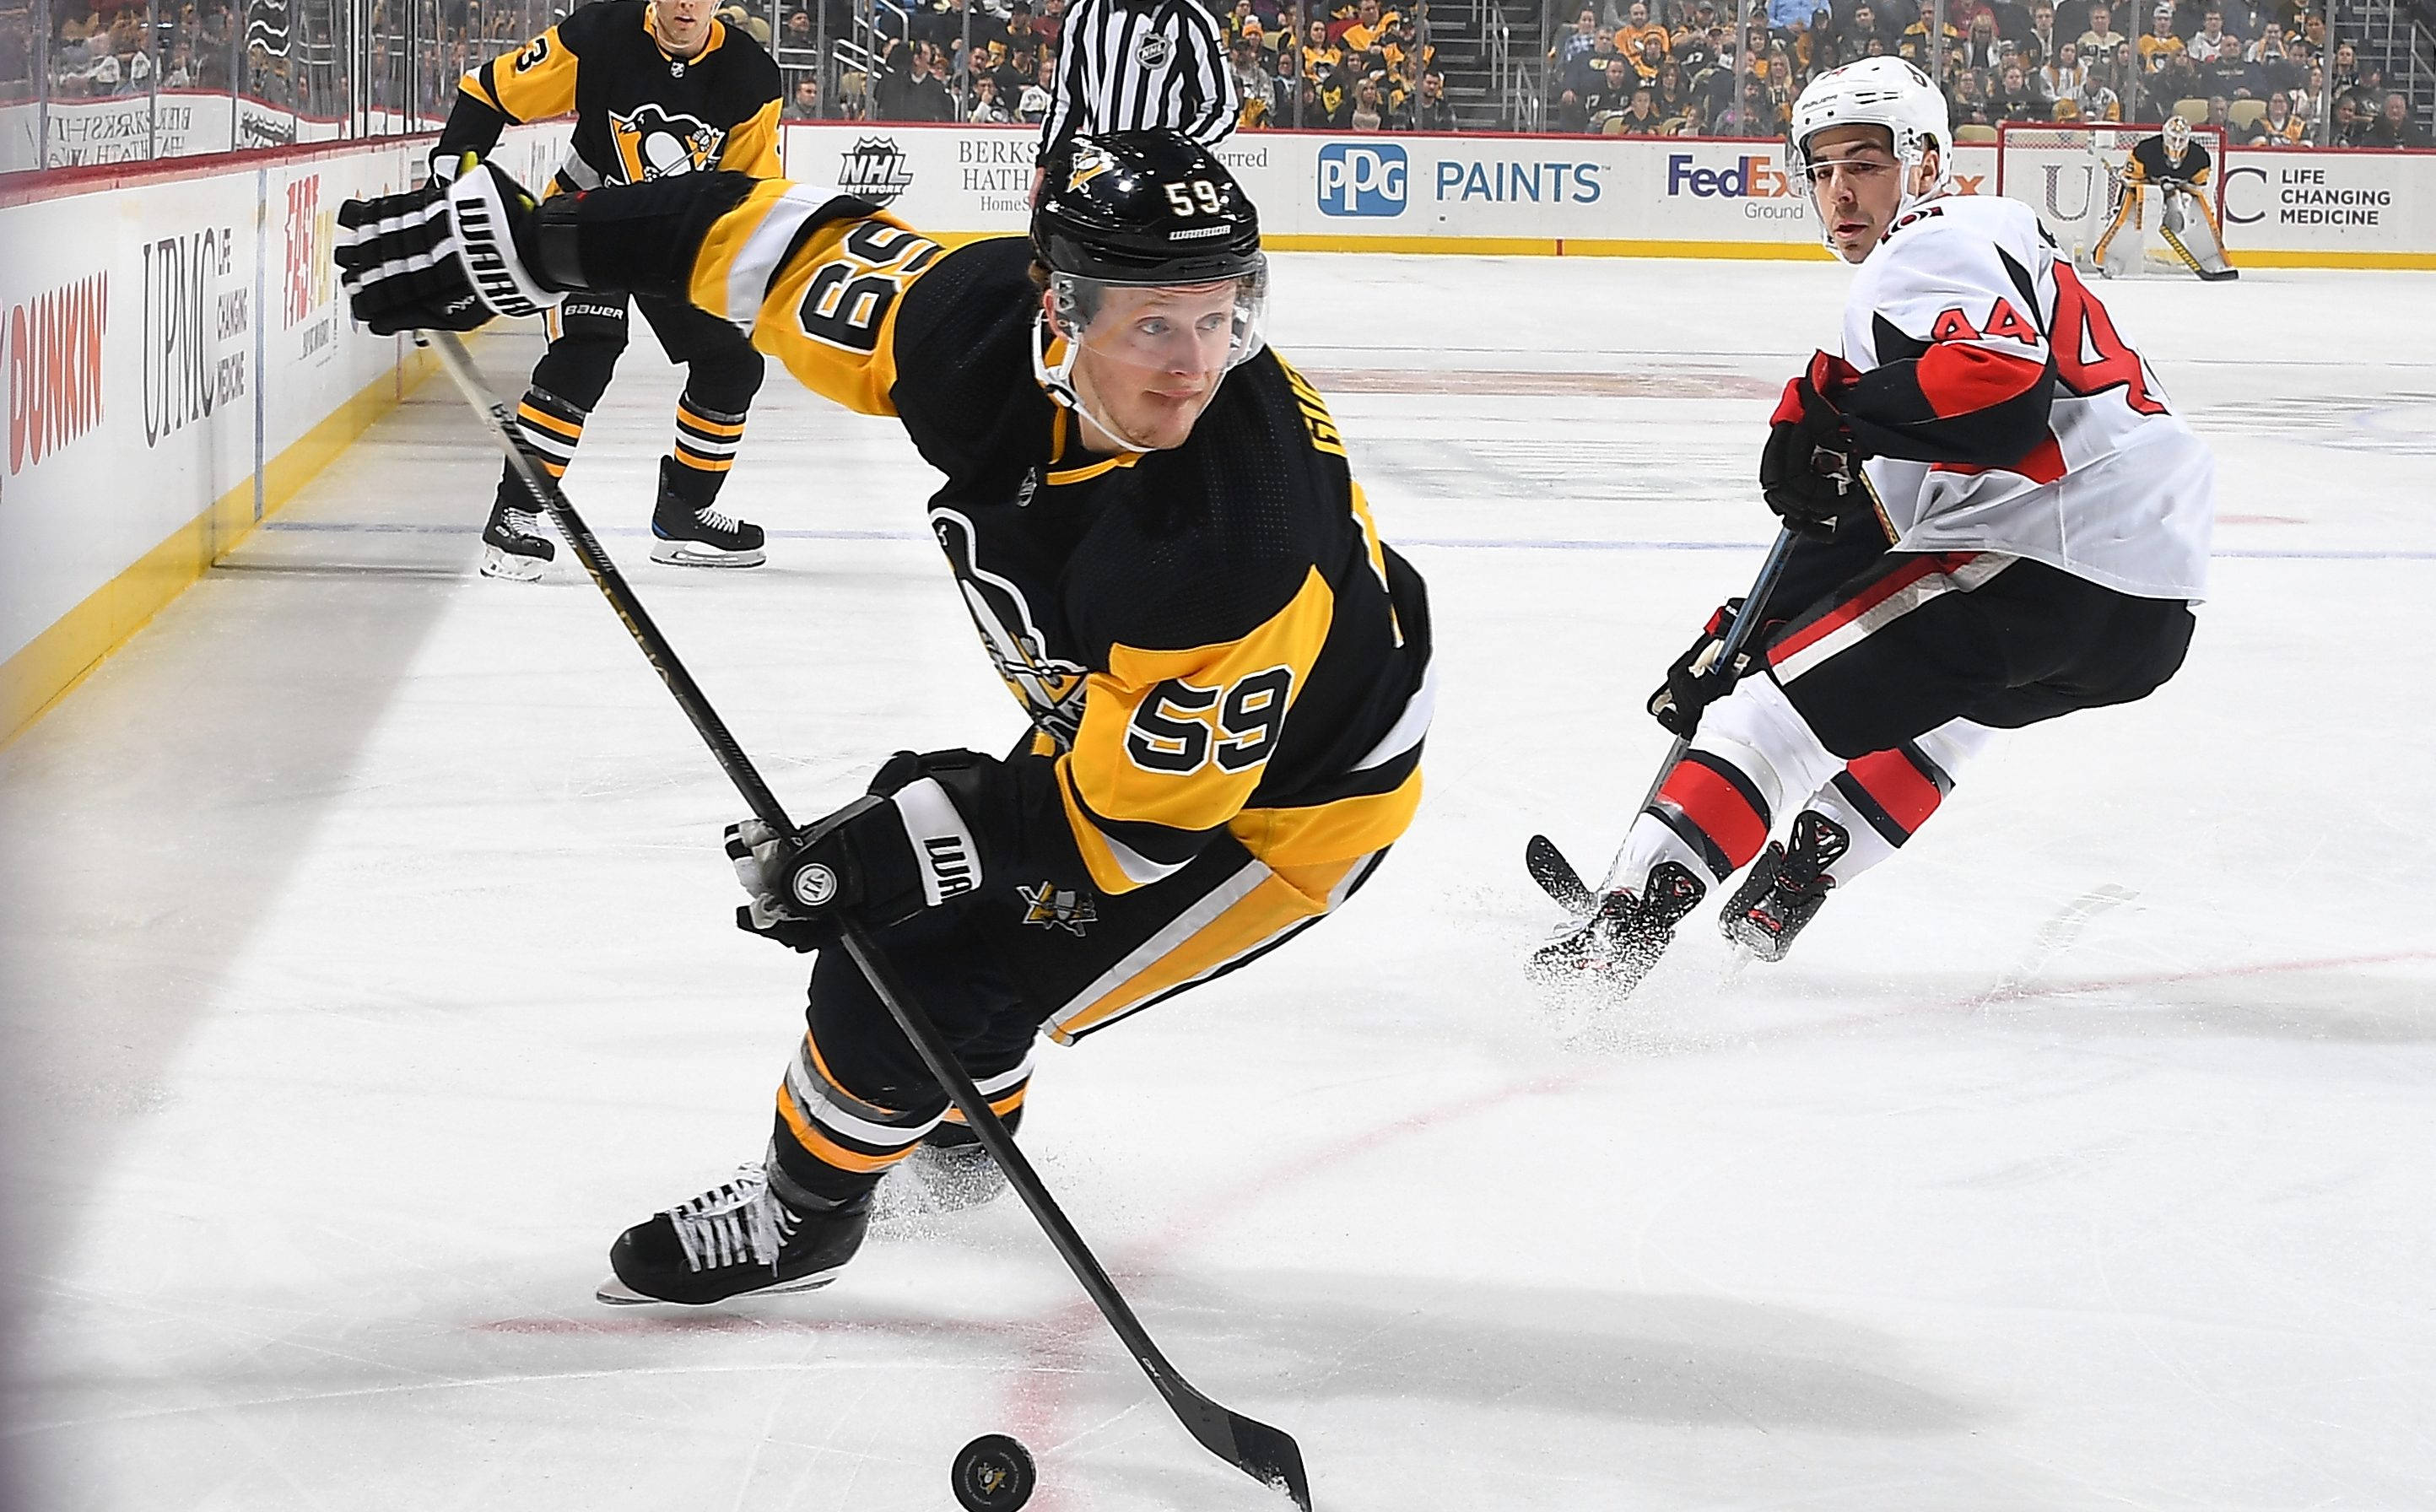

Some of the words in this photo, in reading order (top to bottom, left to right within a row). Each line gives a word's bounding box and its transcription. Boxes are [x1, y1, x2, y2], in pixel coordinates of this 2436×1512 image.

[838, 153, 914, 186] NHL
[964, 168, 1030, 191] HATH
[1436, 160, 1601, 203] PAINTS
[2282, 169, 2325, 185] LIFE
[1164, 180, 1220, 217] 59
[1744, 201, 1804, 221] Ground
[2281, 189, 2391, 207] CHANGING
[2281, 209, 2379, 225] MEDICINE
[798, 219, 945, 354] 59
[564, 304, 624, 321] BAUER
[1931, 296, 2039, 347] 44
[143, 227, 214, 449] UPMC
[1124, 664, 1295, 776] 59
